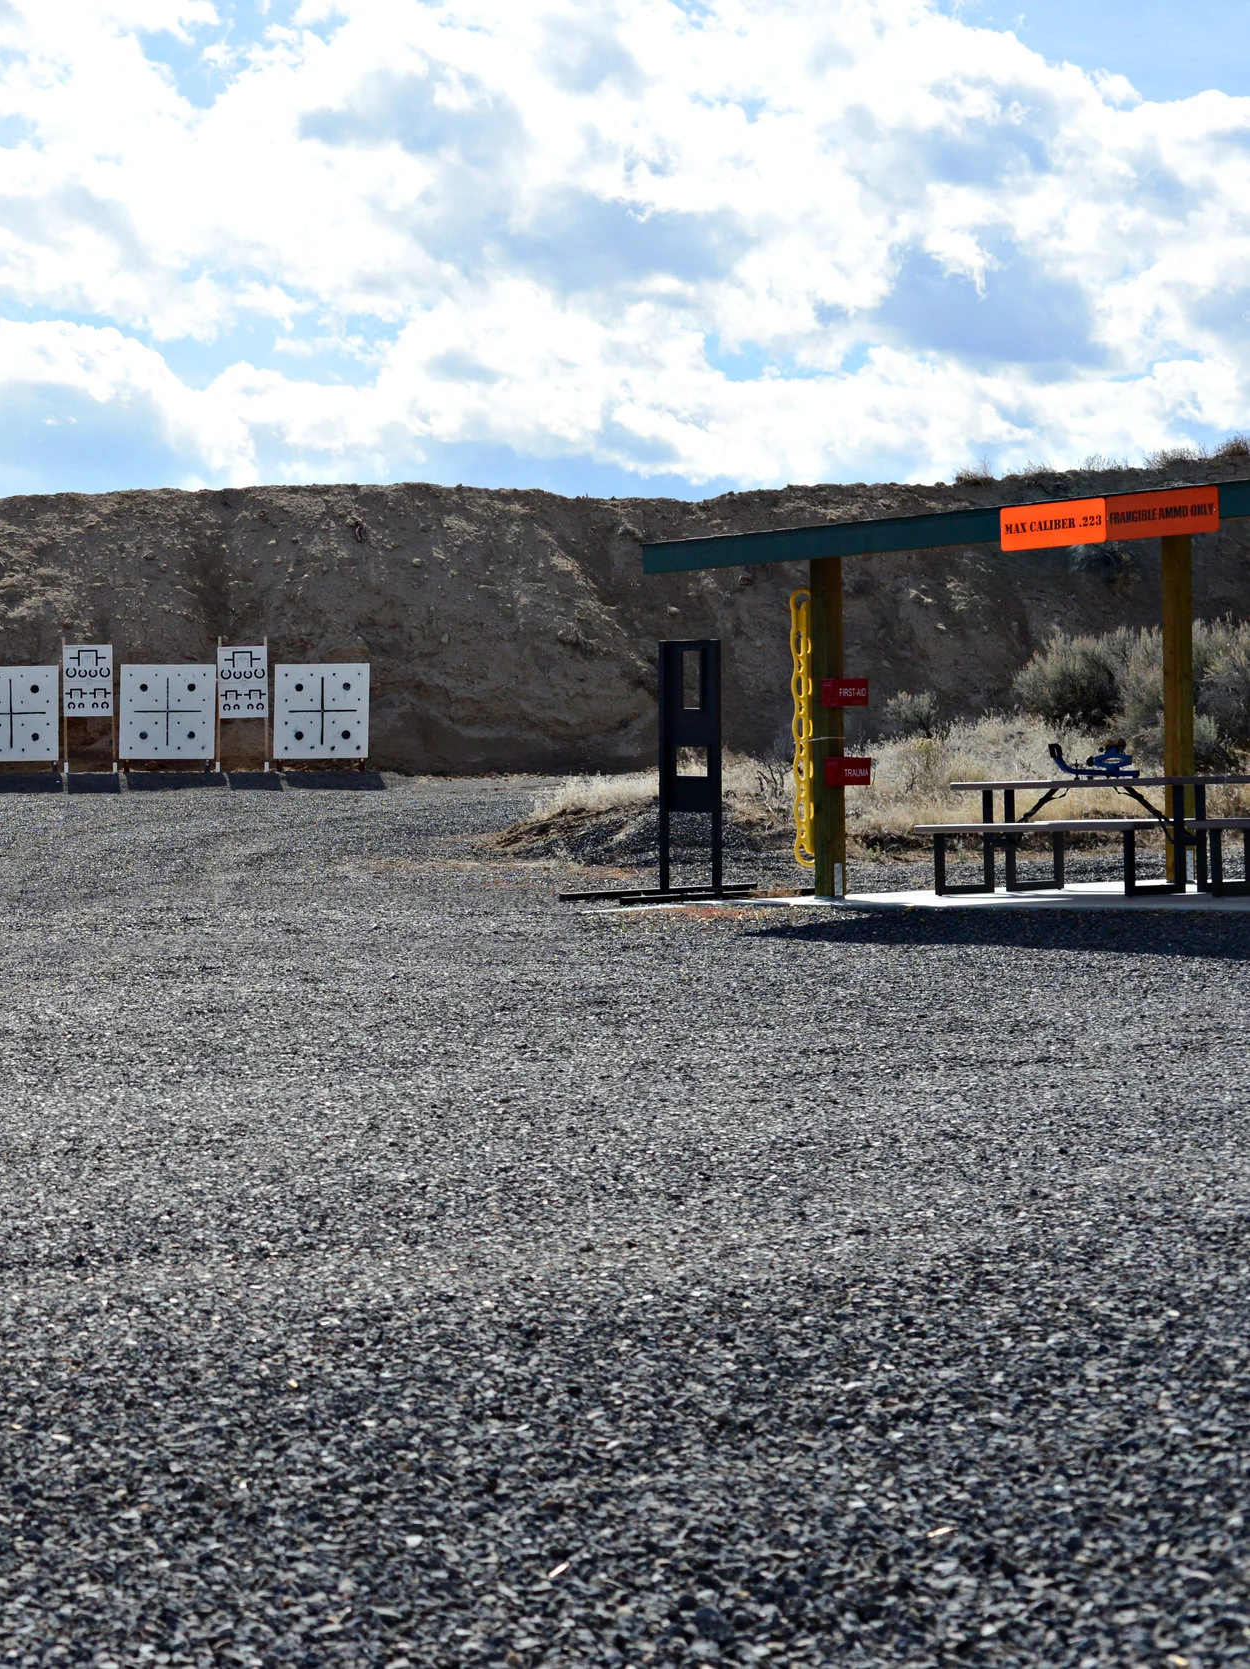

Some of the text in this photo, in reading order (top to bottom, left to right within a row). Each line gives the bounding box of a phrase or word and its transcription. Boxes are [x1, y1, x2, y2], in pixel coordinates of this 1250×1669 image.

[1110, 502, 1214, 525] FRANGIBLE AMMO ONLY
[1005, 514, 1102, 535] MAX CALIBER .223
[839, 688, 867, 697] FIRST-AID
[844, 769, 869, 778] TRAUMA
